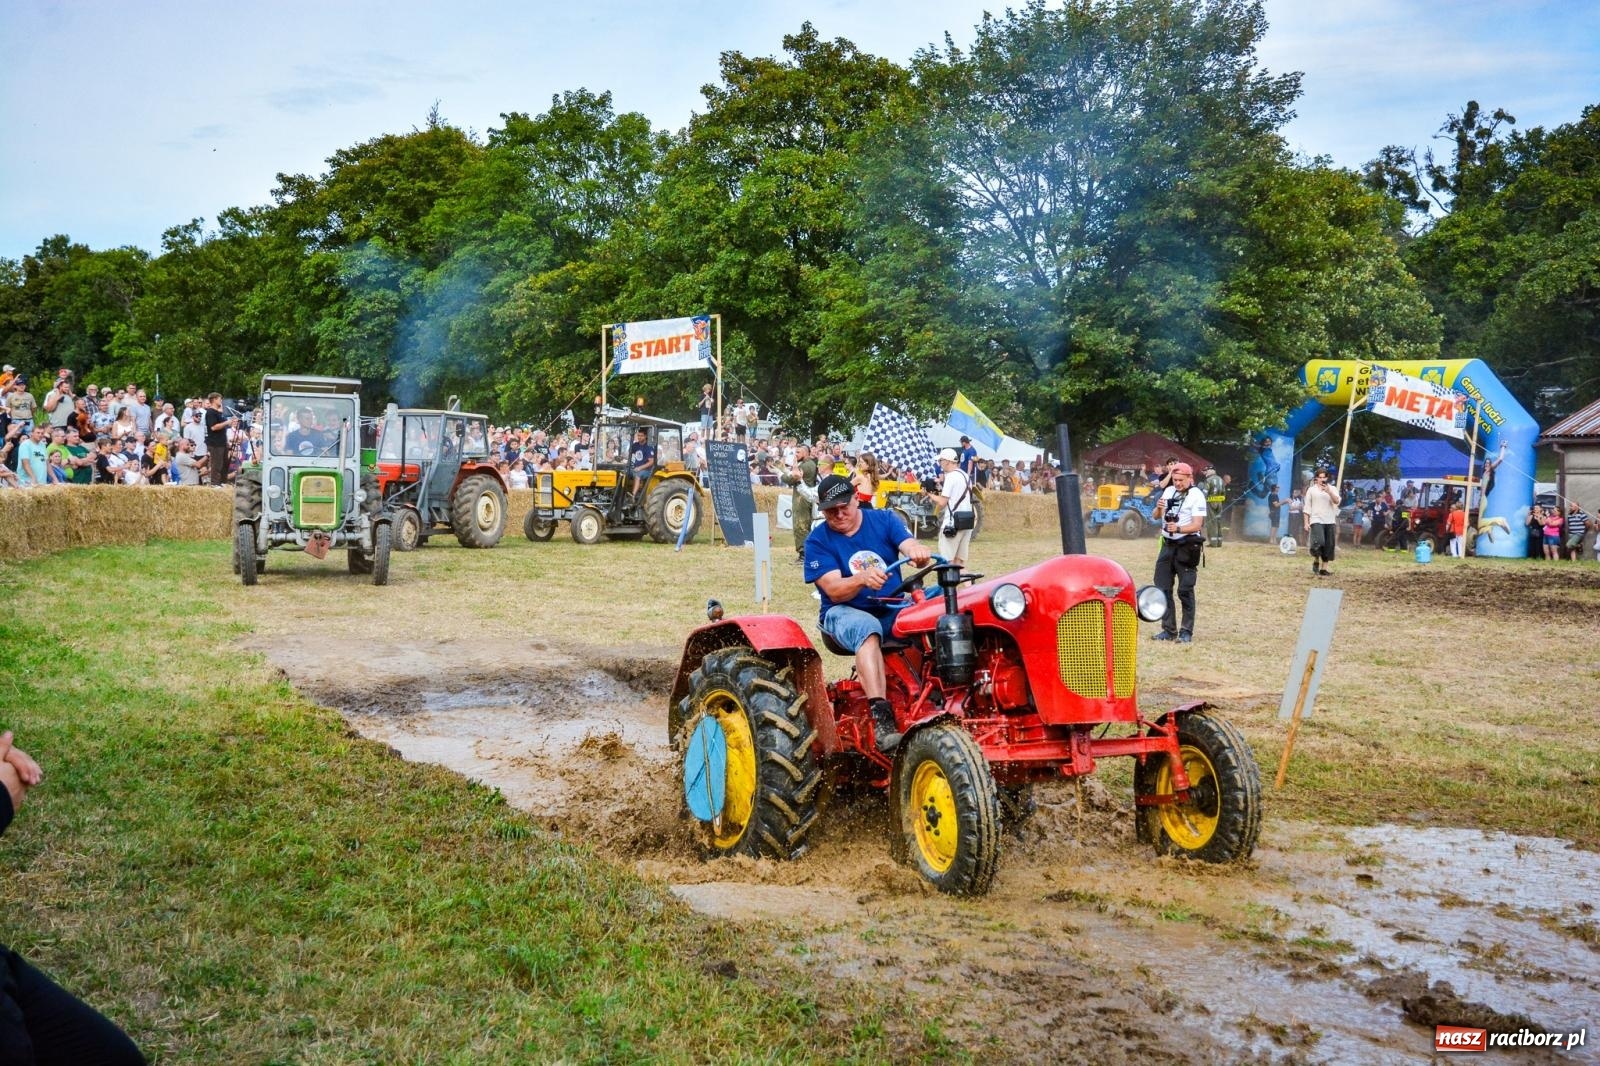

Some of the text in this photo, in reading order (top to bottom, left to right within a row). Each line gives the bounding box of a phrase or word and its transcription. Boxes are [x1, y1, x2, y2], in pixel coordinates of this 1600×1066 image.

[630, 334, 693, 360] START
[1385, 386, 1454, 420] META
[1482, 402, 1505, 426] ludzi
